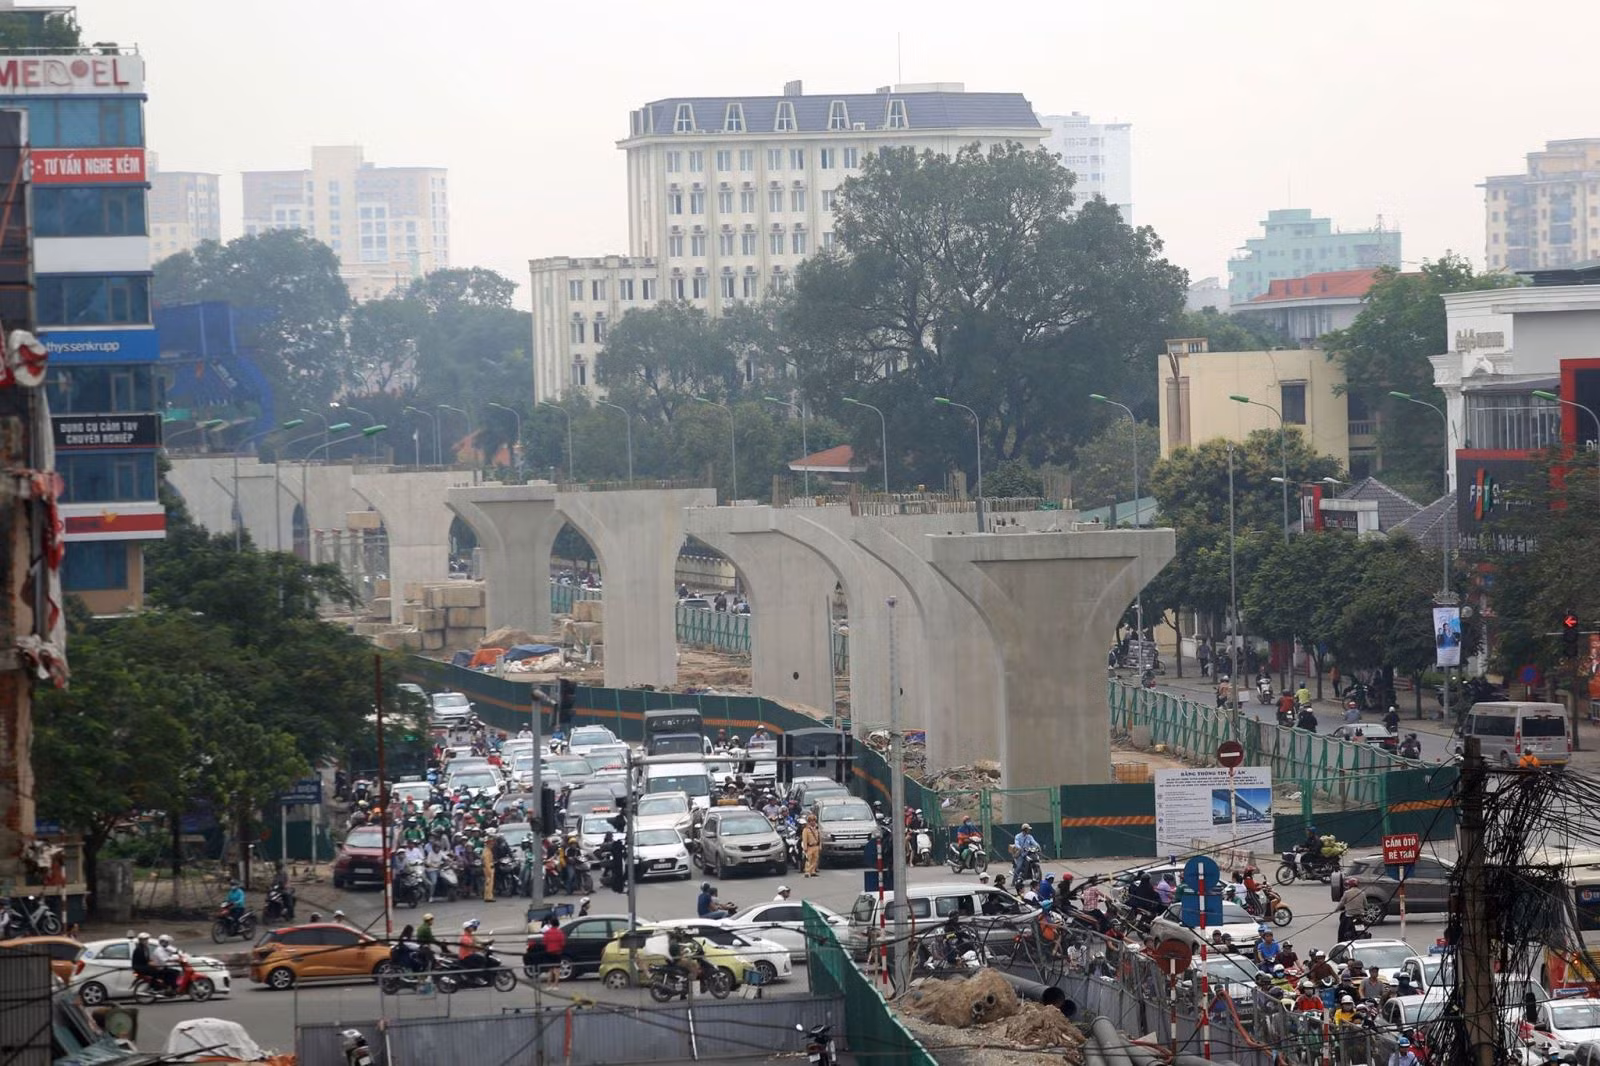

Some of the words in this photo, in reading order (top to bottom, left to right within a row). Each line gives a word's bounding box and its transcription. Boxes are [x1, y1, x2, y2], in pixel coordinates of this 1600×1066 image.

[84, 158, 114, 174] NGHE
[116, 154, 140, 173] KÉM
[1469, 484, 1490, 503] FPT
